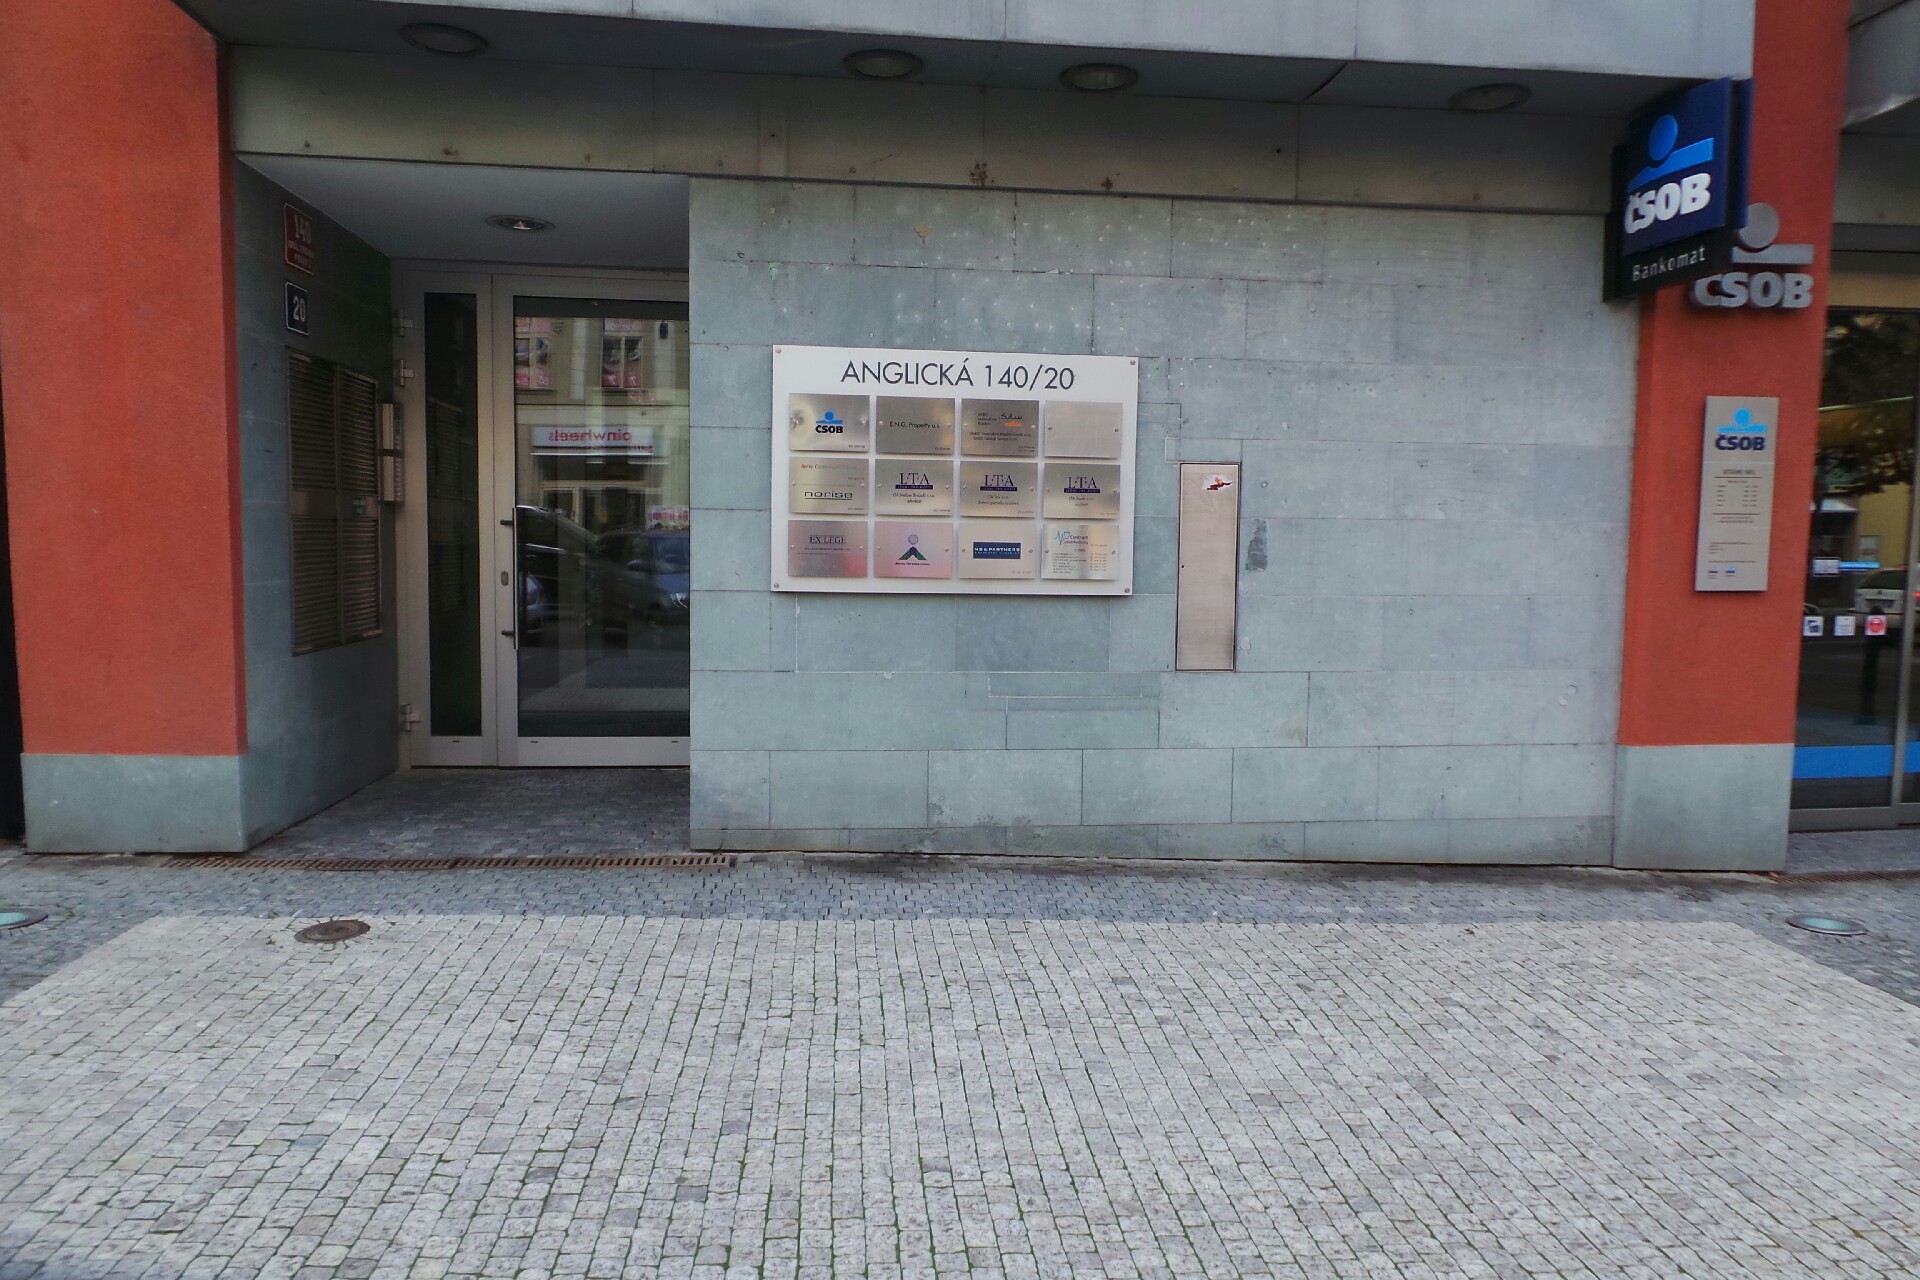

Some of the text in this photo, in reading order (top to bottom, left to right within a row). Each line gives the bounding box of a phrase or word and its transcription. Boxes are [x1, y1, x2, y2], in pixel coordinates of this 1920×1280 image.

[293, 213, 313, 246] 140
[1632, 245, 1706, 282] Bankomat
[292, 295, 306, 323] 20
[840, 357, 1075, 391] ANGLICKÁ 140/20
[908, 422, 931, 430] Property
[1714, 433, 1766, 451] ČSOB
[804, 490, 853, 498] norise
[809, 535, 847, 544] EX LEGE
